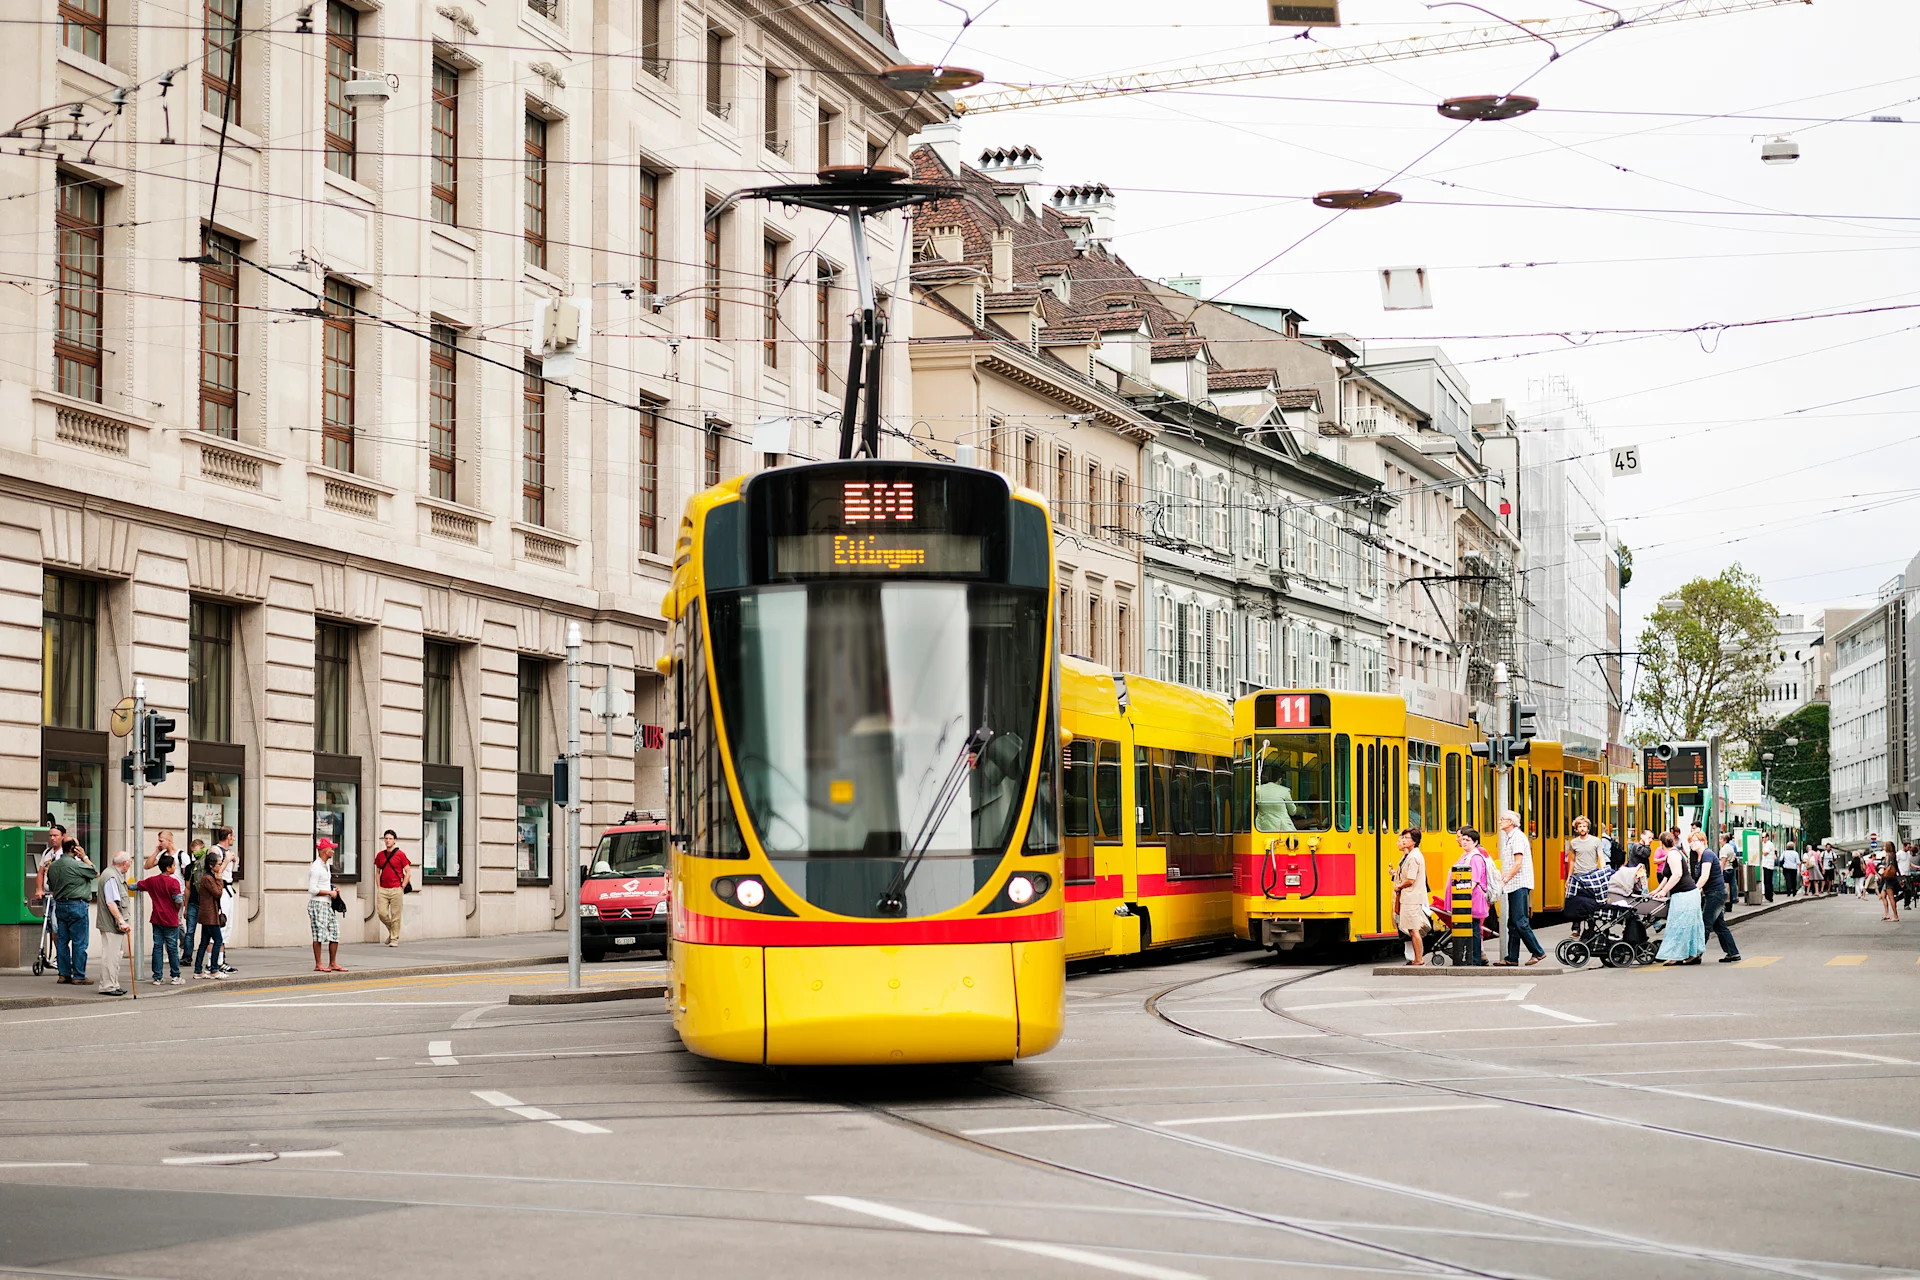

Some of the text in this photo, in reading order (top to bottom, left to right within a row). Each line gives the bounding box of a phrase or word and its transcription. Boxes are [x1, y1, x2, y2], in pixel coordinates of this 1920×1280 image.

[1615, 450, 1636, 470] 45
[1280, 697, 1305, 723] 11
[645, 723, 665, 750] UBS
